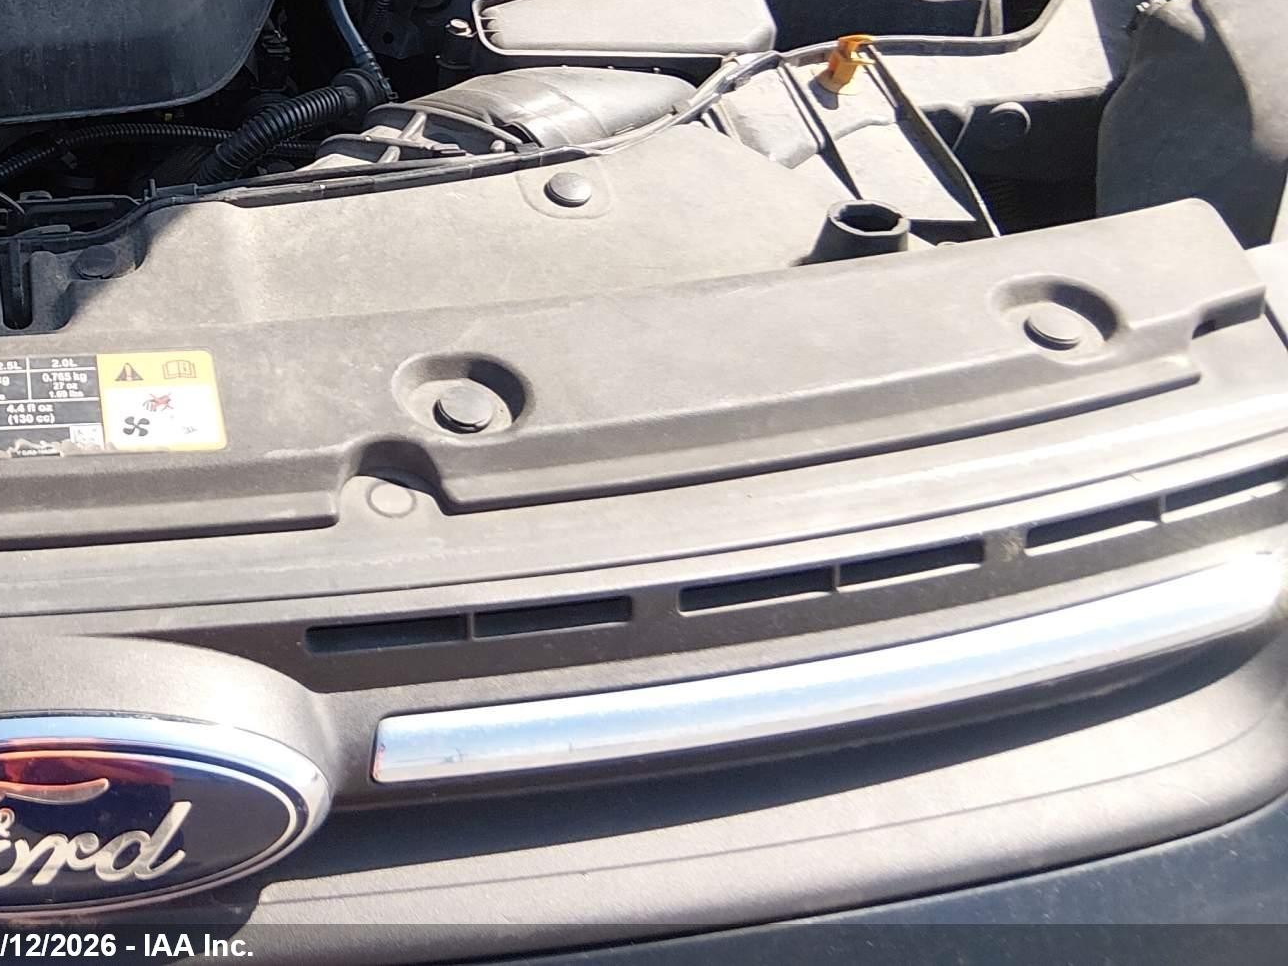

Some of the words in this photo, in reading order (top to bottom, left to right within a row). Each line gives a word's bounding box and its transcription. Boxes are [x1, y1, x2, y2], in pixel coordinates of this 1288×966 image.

[51, 358, 78, 367] 2.0L
[73, 372, 88, 382] kg
[6, 404, 25, 413] 4.4
[27, 404, 36, 412] fl
[38, 404, 53, 412] oz
[7, 414, 34, 425] (130
[36, 413, 55, 425] cc)
